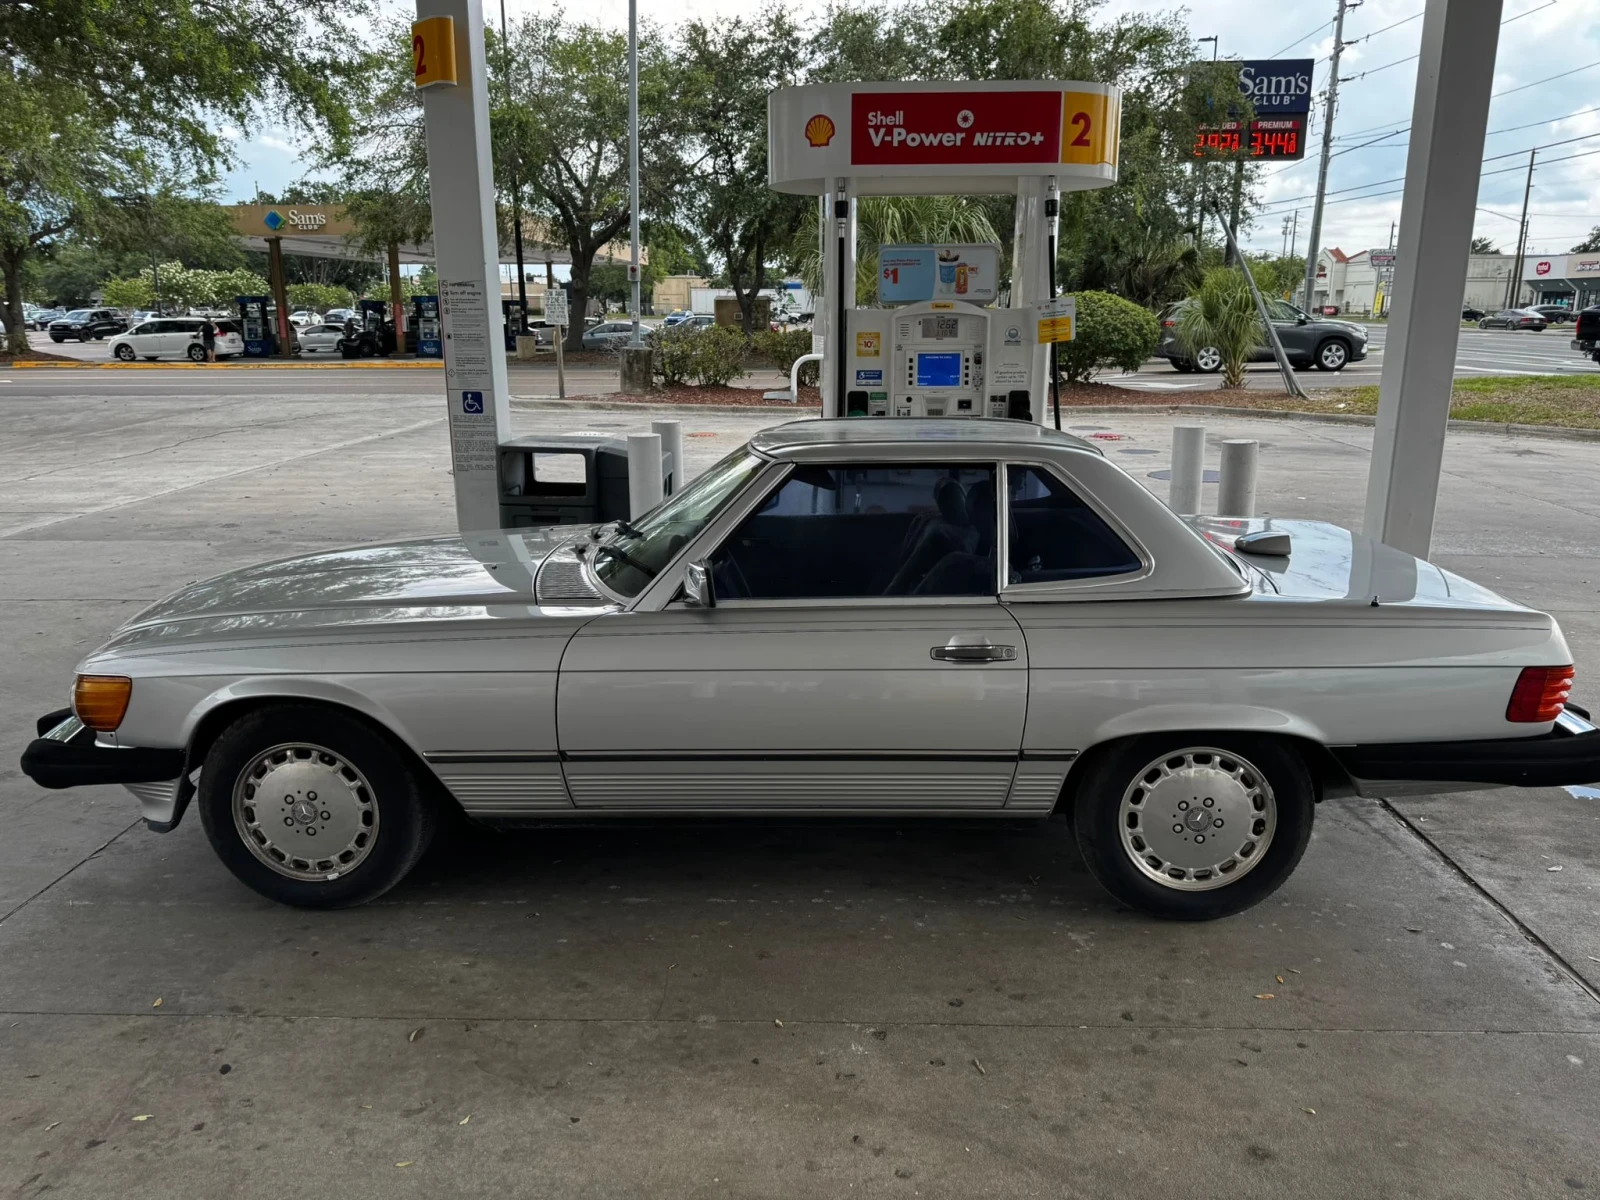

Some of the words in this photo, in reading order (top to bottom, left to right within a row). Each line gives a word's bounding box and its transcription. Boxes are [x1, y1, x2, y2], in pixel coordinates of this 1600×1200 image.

[413, 34, 427, 77] 2
[1238, 67, 1309, 96] Sam's
[1253, 95, 1291, 105] CLUB
[867, 111, 904, 126] Shell
[1257, 121, 1293, 129] PREMIUM
[868, 127, 966, 147] V-Power
[1070, 112, 1092, 148] 2
[288, 209, 326, 225] Sam's
[883, 267, 899, 284] $1
